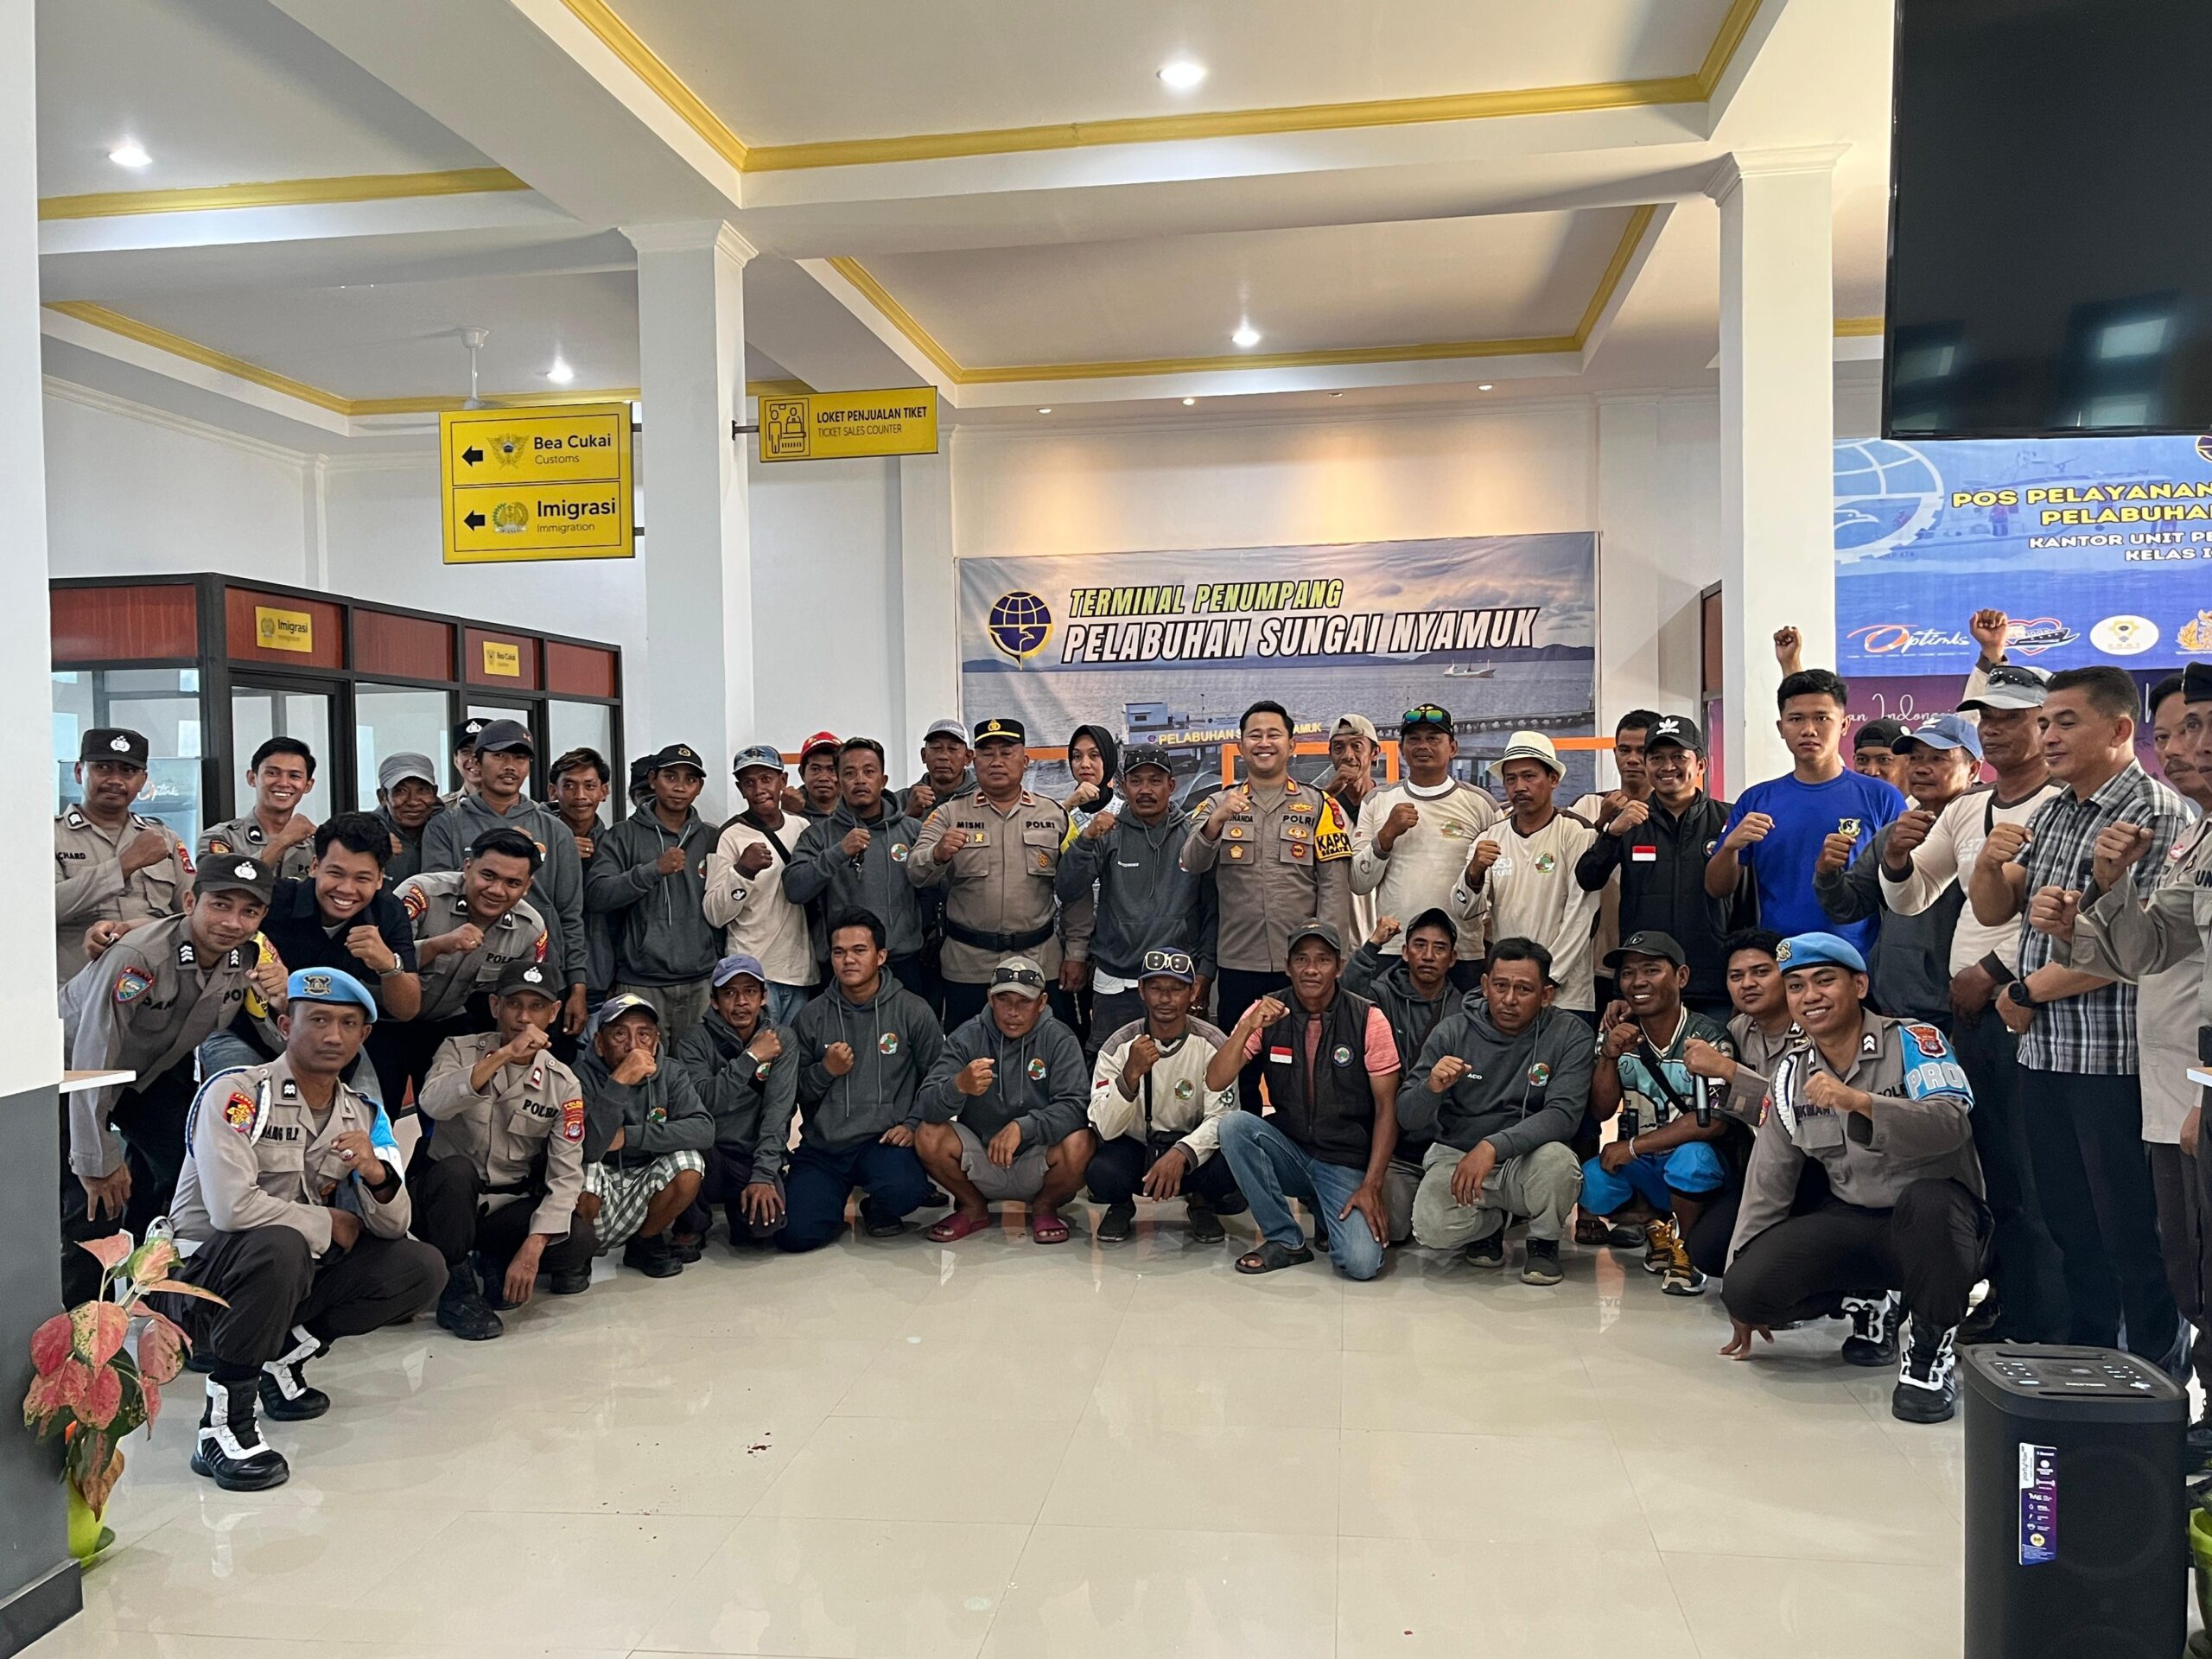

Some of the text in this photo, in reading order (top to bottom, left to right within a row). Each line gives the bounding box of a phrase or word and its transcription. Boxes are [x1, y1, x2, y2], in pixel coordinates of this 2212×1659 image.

[817, 406, 927, 423] LOKET PENJUALAN TIKET
[817, 423, 902, 437] TICKET SALES COUNTER
[534, 433, 611, 449] Bea Cukai
[535, 454, 580, 465] Customs
[1952, 490, 2018, 507] POS
[537, 497, 615, 520] Imigrasi
[2041, 504, 2212, 525] PELABUHA
[537, 524, 594, 534] Immigration
[2029, 533, 2123, 549] KANTOR
[2129, 531, 2185, 545] UNIT
[2125, 548, 2196, 562] KELAS
[1069, 579, 1344, 618] TERMINAL PENUMPANG
[277, 619, 308, 634] Imigrasi
[1061, 607, 1541, 664] PELABUHAN SUNGAI NYAMUK
[1293, 722, 1321, 734] AMUK
[1158, 729, 1235, 745] PELABUHAN
[1026, 821, 1055, 830] POLRI
[1283, 815, 1315, 826] POLRI
